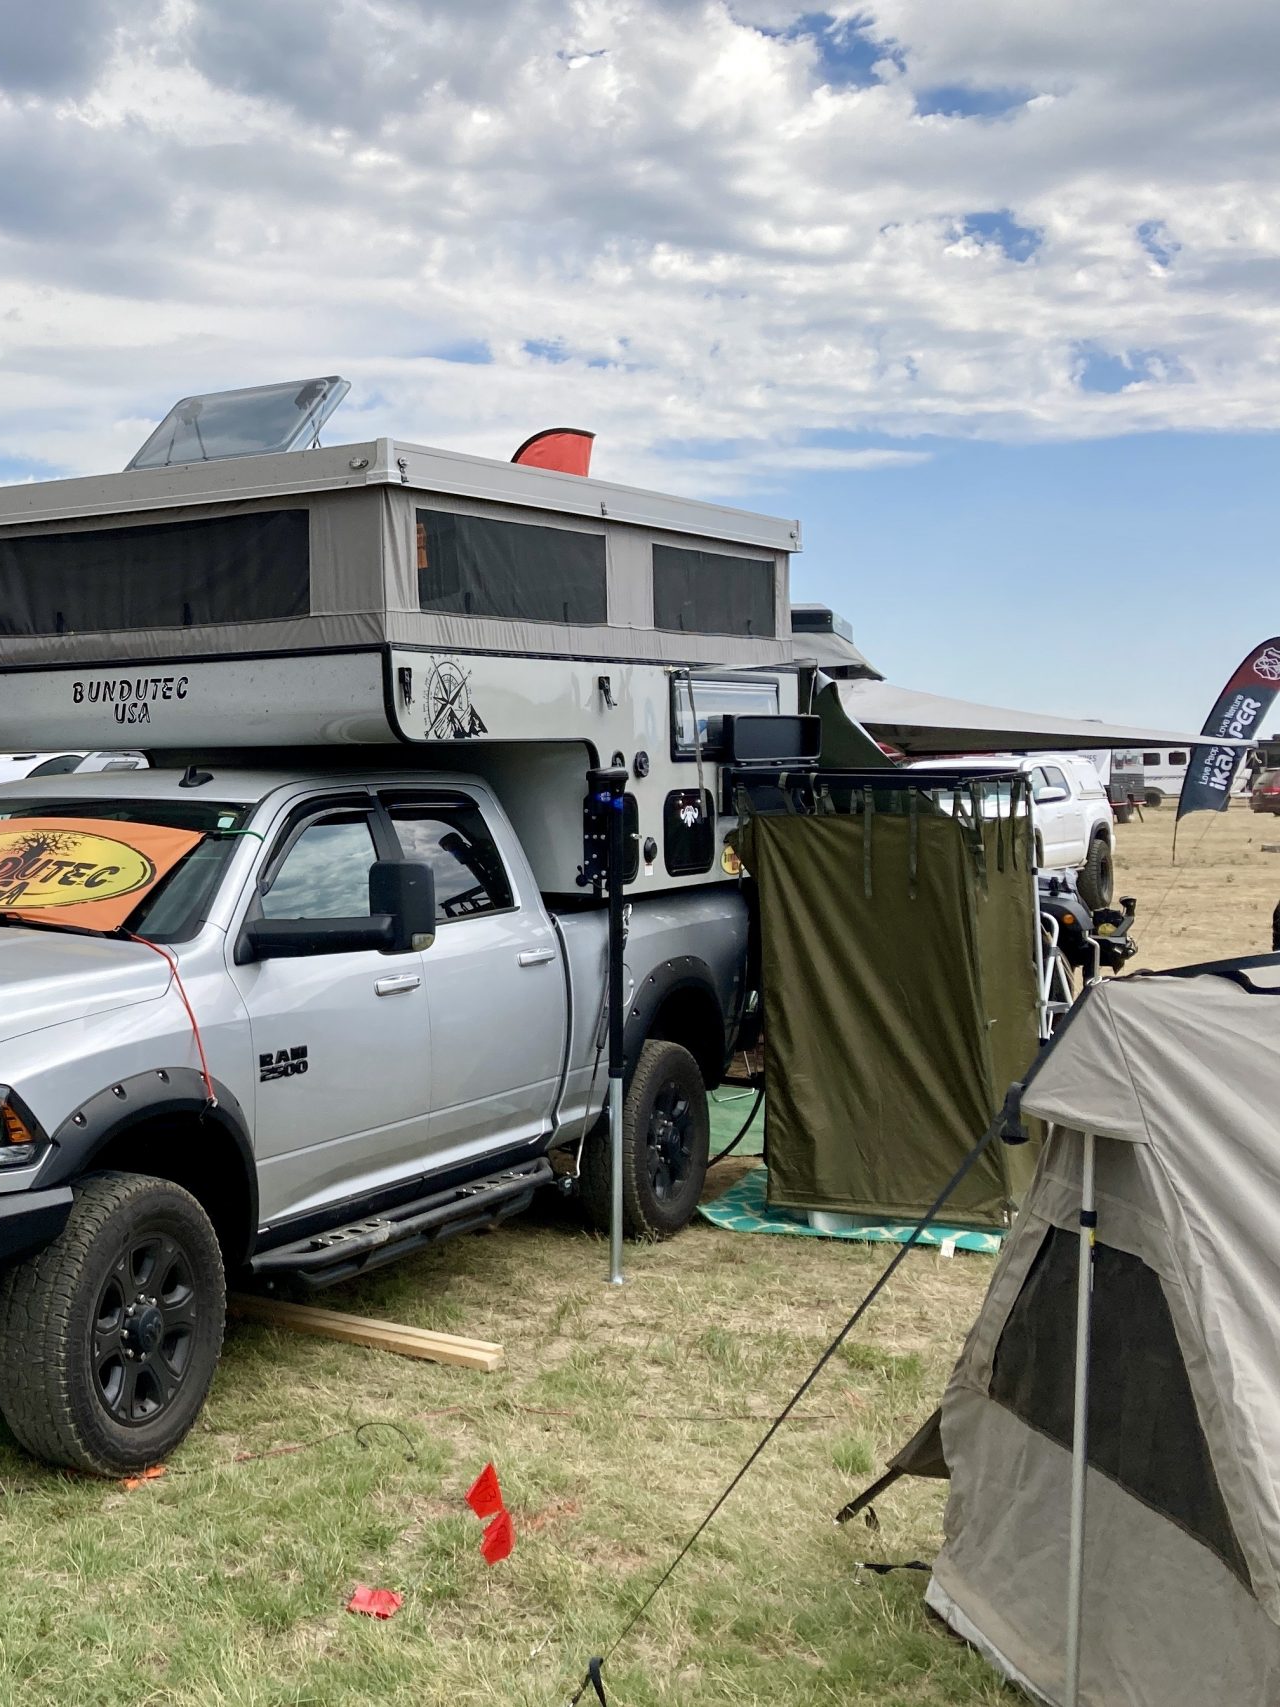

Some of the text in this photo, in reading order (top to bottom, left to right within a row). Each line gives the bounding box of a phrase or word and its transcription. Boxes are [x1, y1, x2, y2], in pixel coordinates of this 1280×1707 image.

[72, 676, 189, 703] BUNDUTEC
[114, 702, 151, 724] USA
[1199, 766, 1211, 785] Love
[259, 1045, 308, 1068] RAM
[260, 1060, 309, 1083] 2500
